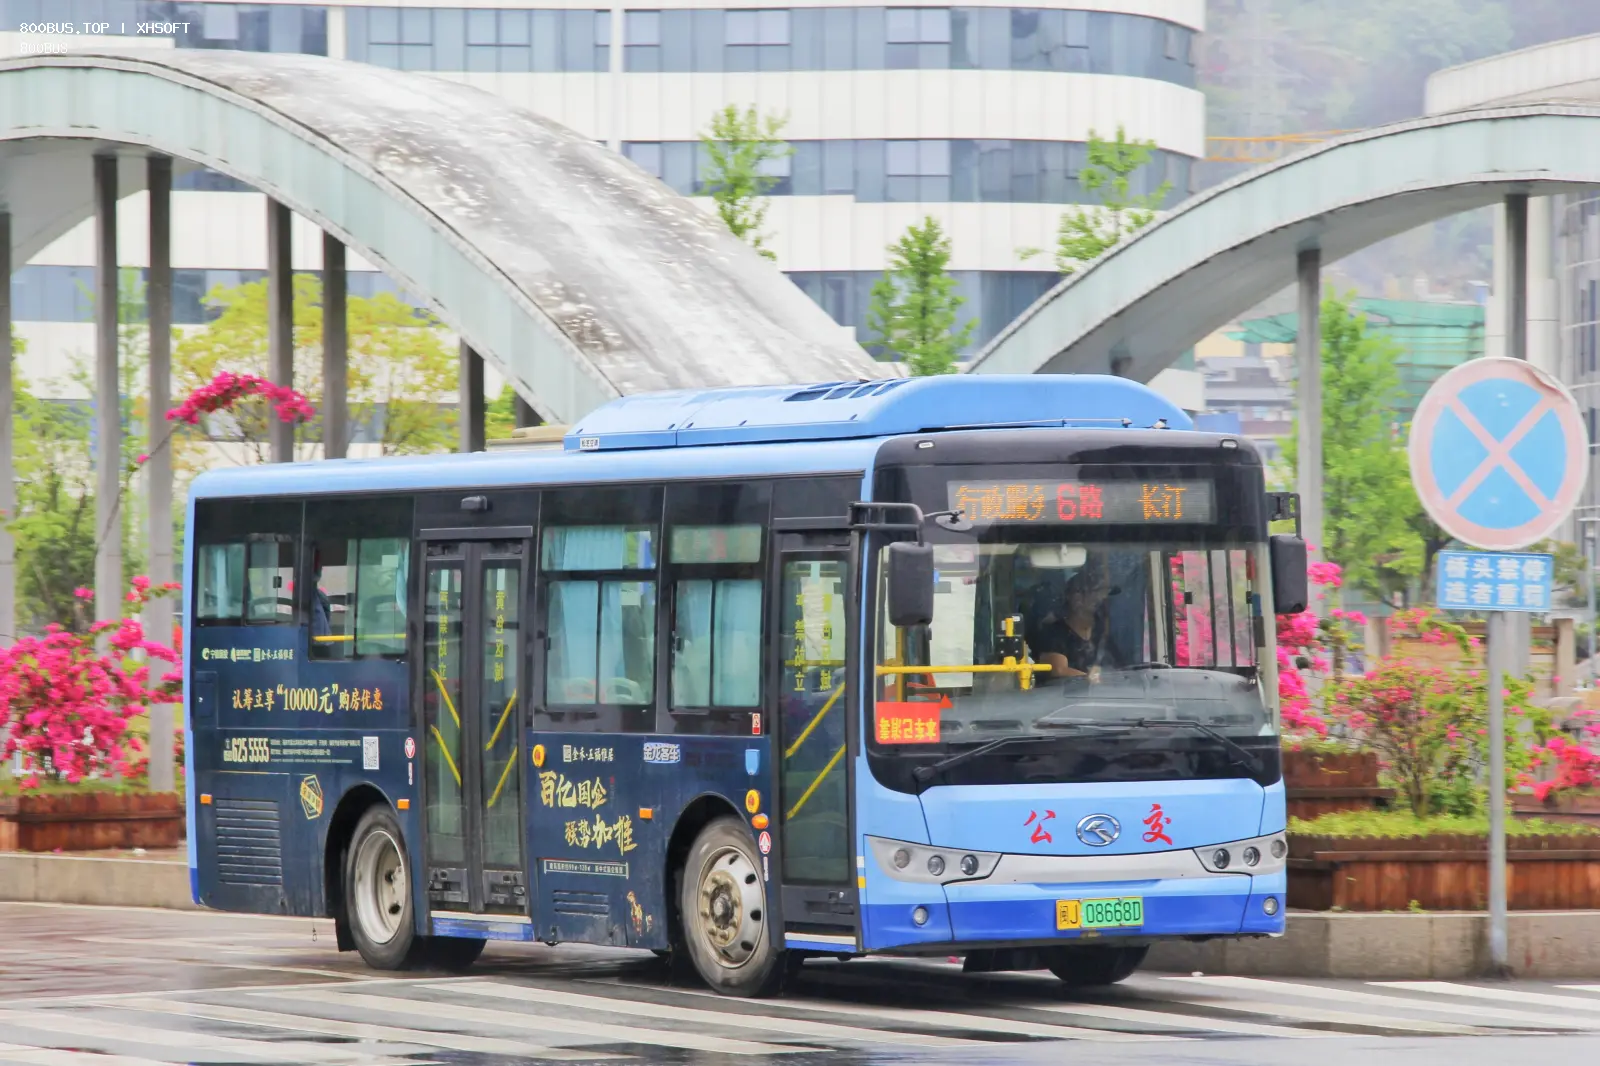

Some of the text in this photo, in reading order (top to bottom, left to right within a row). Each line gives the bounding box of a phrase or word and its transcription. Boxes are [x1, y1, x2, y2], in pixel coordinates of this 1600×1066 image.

[1057, 484, 1104, 521] 6路
[1023, 803, 1173, 845] 公 交
[1086, 901, 1141, 923] 08668D
